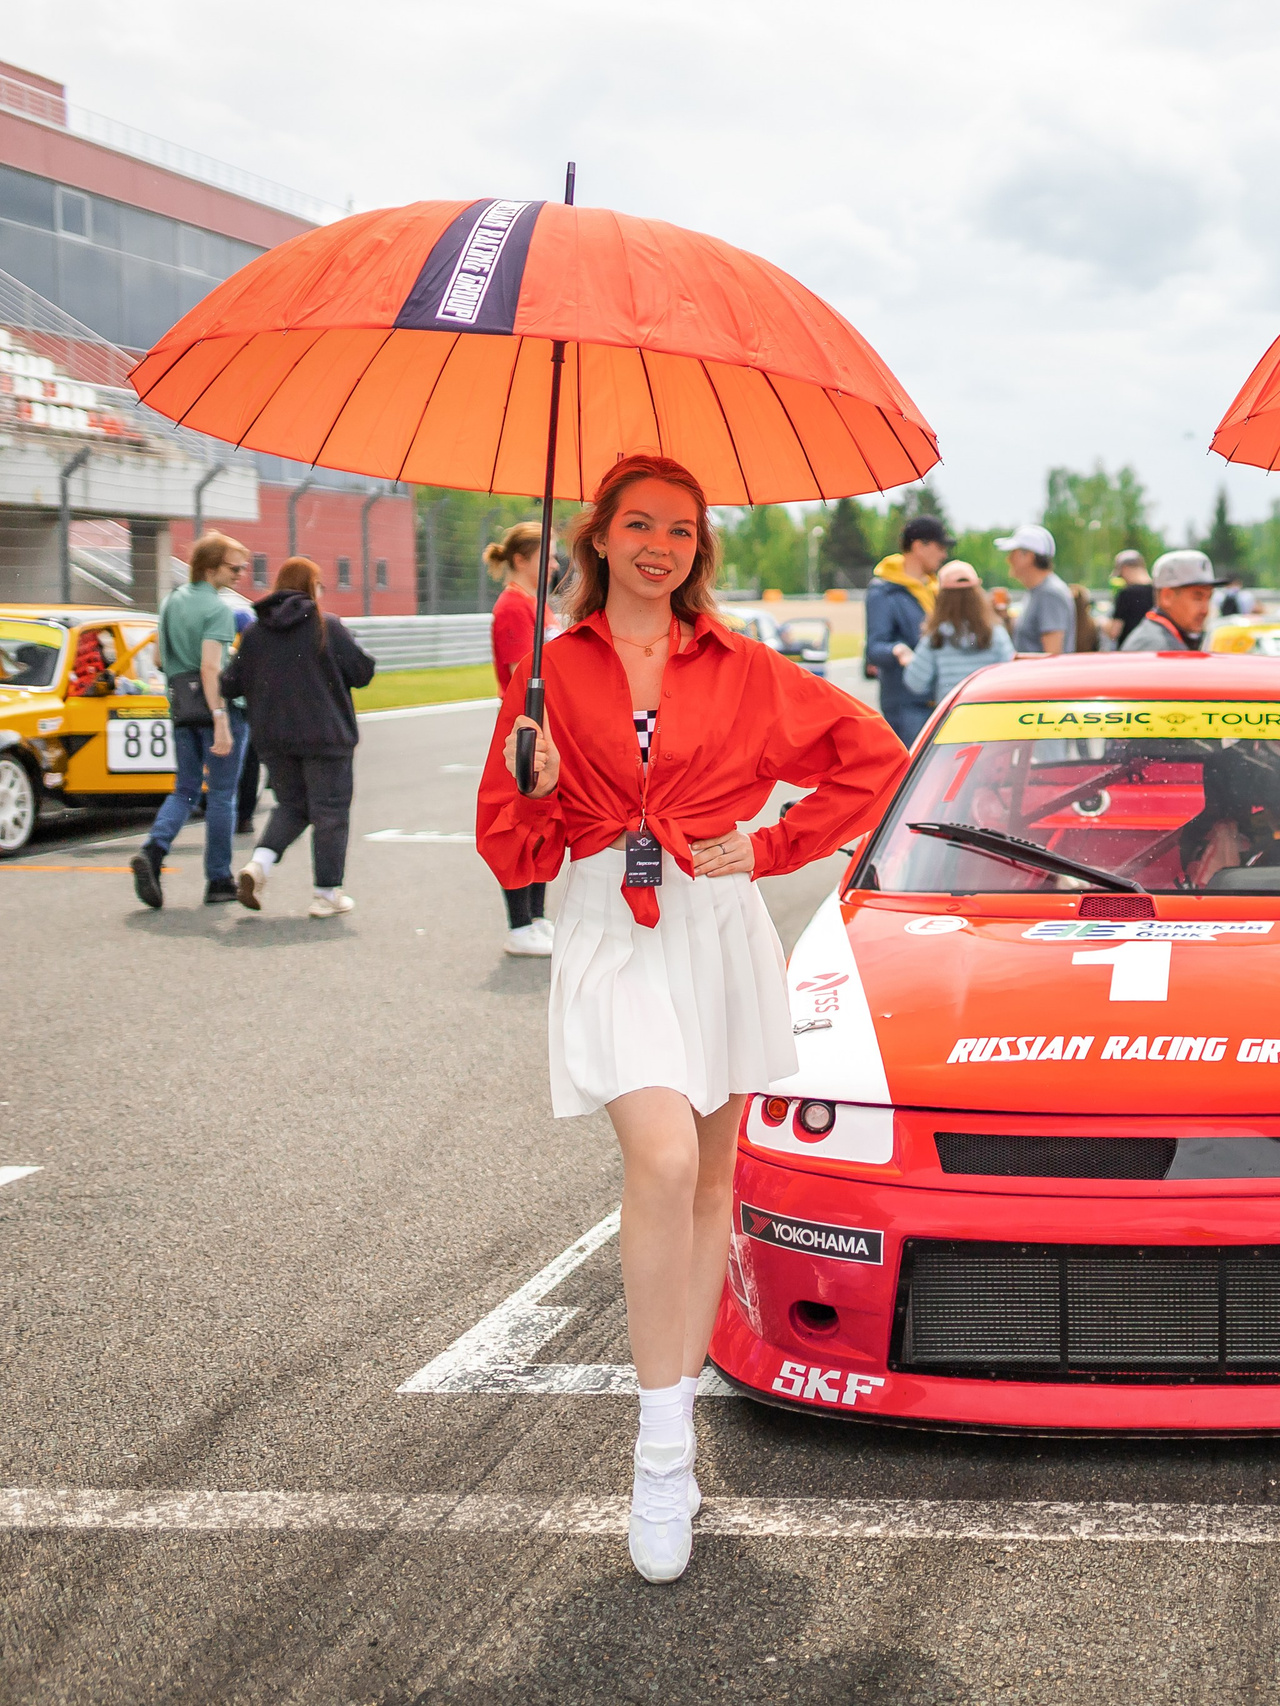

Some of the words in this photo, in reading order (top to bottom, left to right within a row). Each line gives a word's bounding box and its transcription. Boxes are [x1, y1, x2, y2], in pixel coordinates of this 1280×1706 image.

[461, 228, 506, 274] RACING
[444, 273, 486, 318] GROUP
[1018, 712, 1151, 724] CLASSIC
[124, 721, 167, 758] 88
[941, 745, 984, 802] 1
[1135, 930, 1202, 938] банк
[1137, 922, 1264, 931] Земский
[1072, 941, 1173, 1001] 1
[814, 989, 840, 1013] TSS
[946, 1036, 1095, 1064] RUSSIAN
[1100, 1036, 1229, 1061] RACING
[771, 1221, 870, 1256] YOKOHAMA
[771, 1360, 886, 1405] SKF
